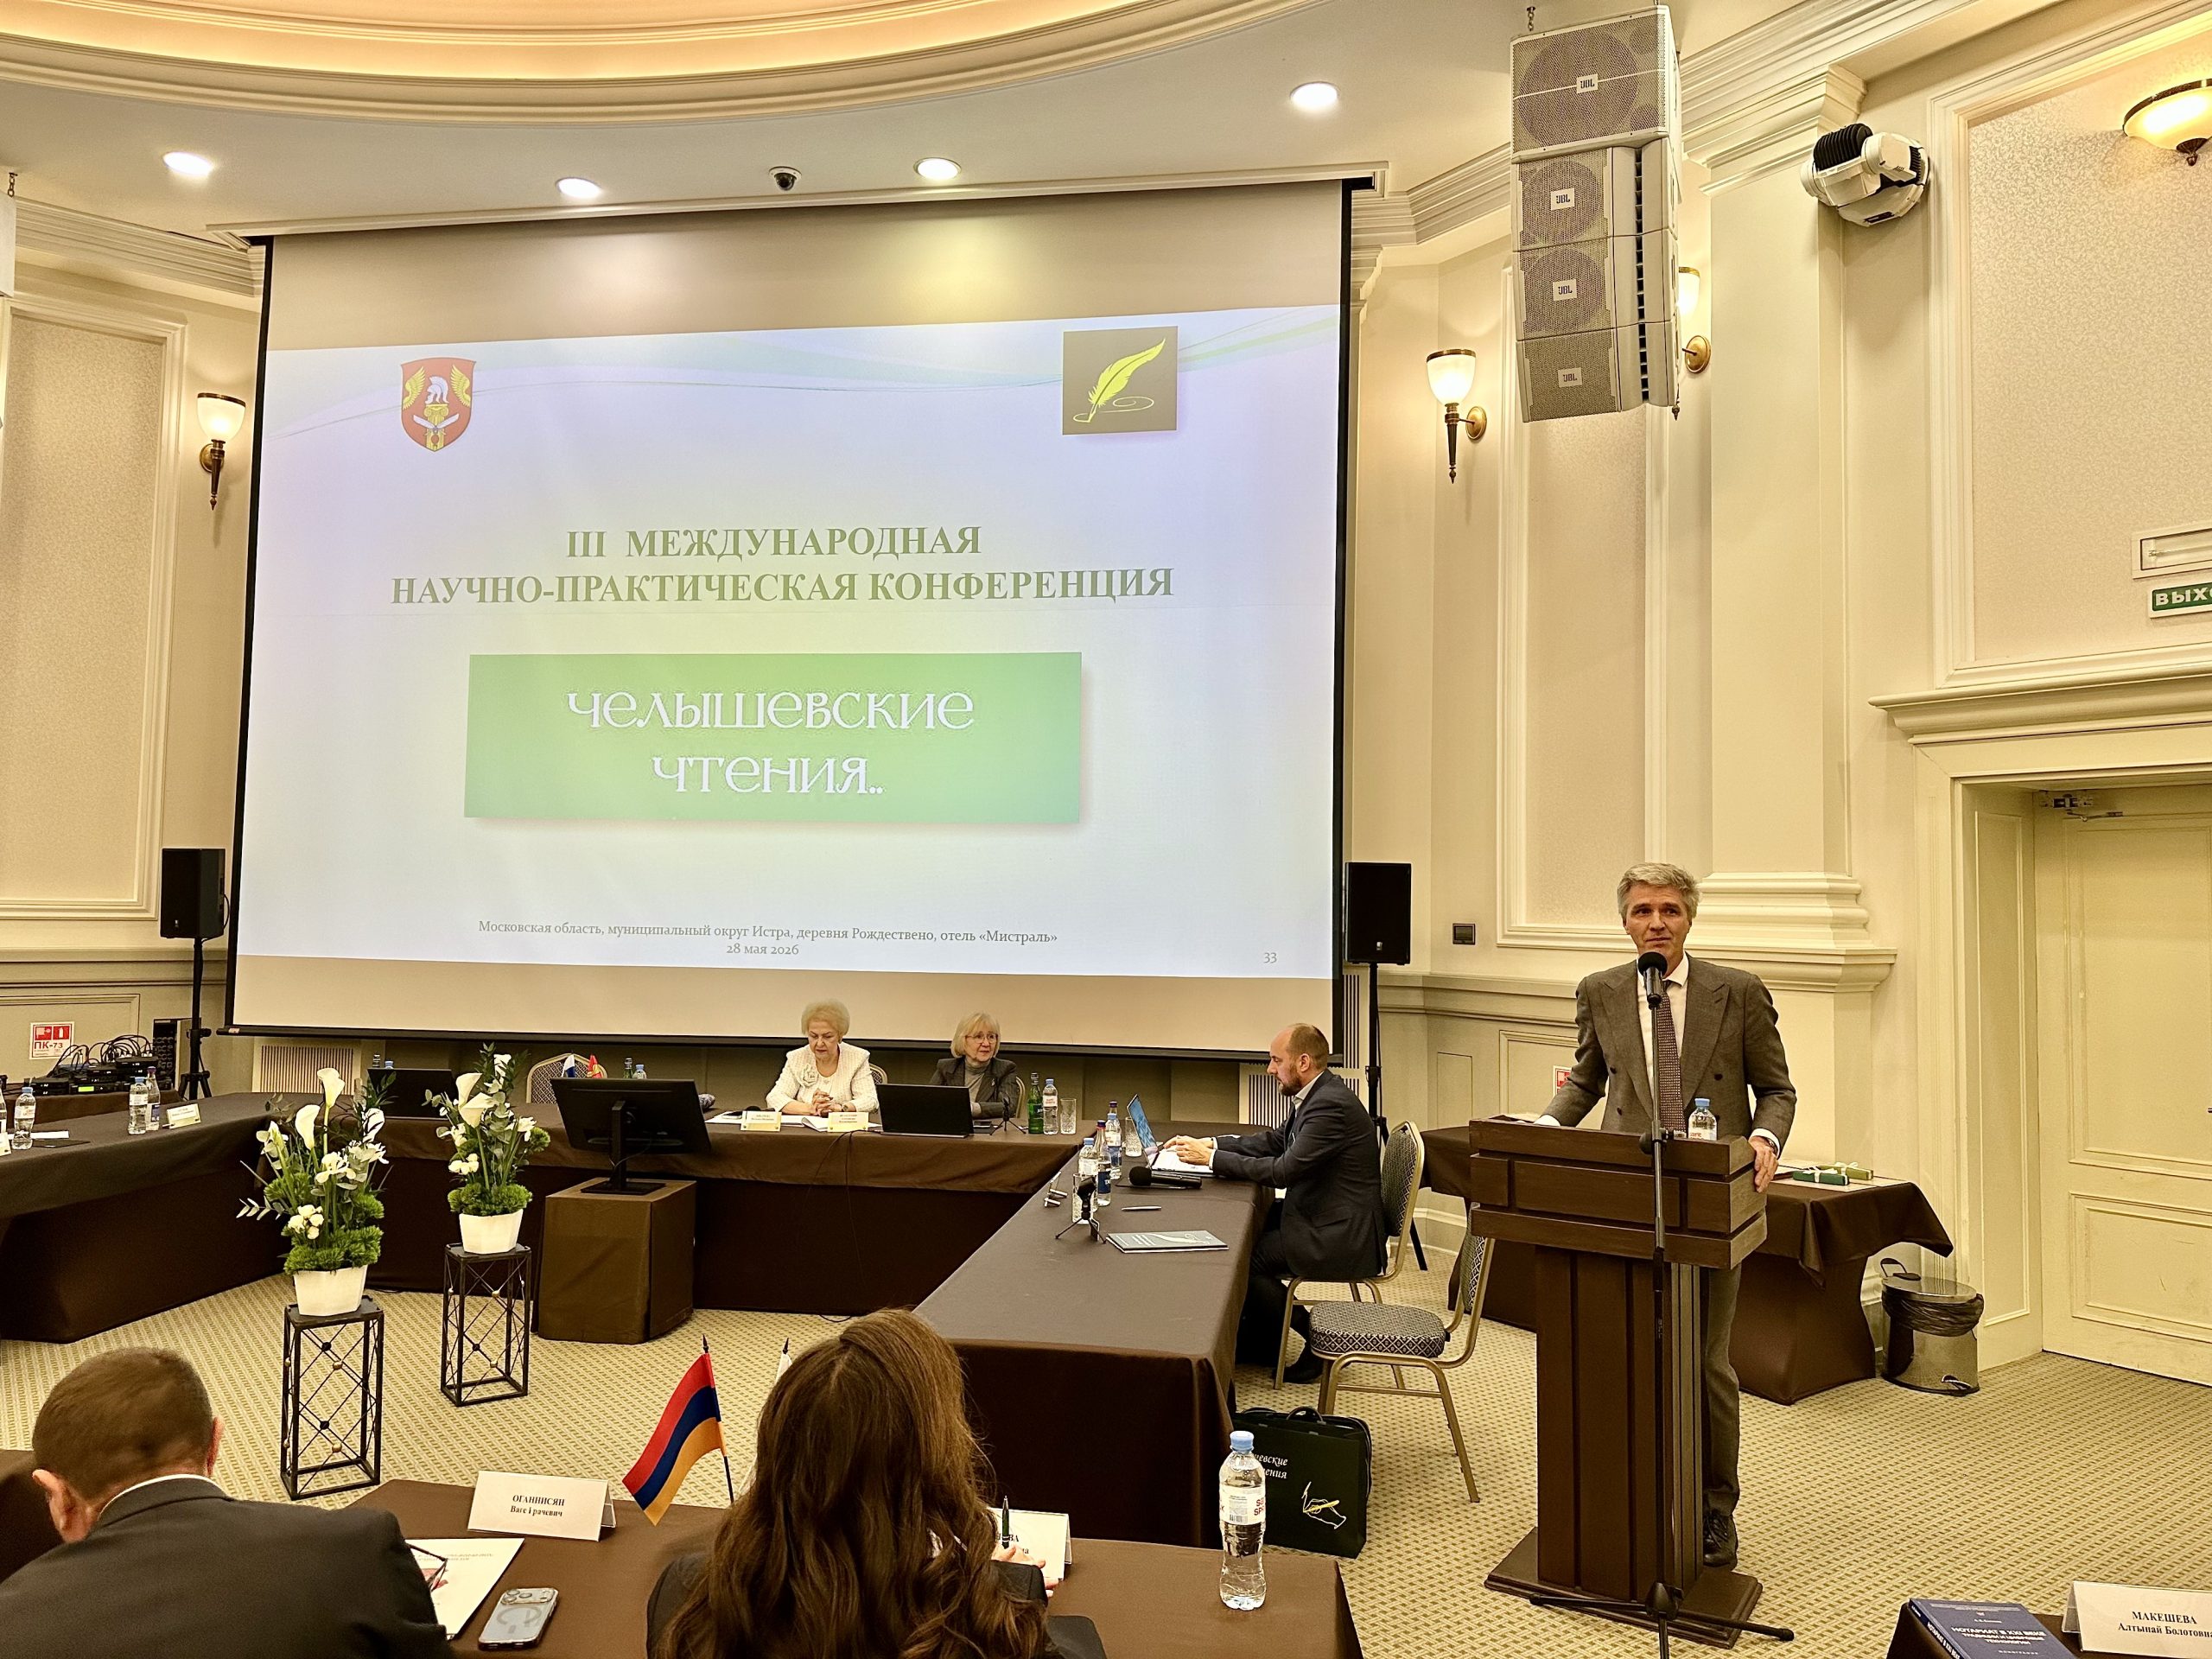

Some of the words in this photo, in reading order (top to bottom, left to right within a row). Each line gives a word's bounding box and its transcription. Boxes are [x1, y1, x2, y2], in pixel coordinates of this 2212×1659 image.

[1556, 194, 1571, 204] JBL
[1558, 285, 1573, 295] JBL
[1563, 373, 1578, 382] JBL
[627, 526, 982, 563] МЕЖДУНАРОДНАЯ
[391, 573, 858, 604] НАУЧНО-ПРАКТИЧЕСКАЯ
[868, 568, 1174, 603] КОНФЕРЕНЦИЯ
[2155, 587, 2212, 606] ВЫХ
[479, 920, 551, 933] Московская
[554, 922, 605, 935] область,
[607, 925, 710, 938] муниципальный
[714, 928, 749, 940] округ
[753, 925, 793, 941] Истра,
[797, 929, 849, 941] деревня
[852, 928, 937, 942] Рождествено,
[940, 932, 976, 941] отель
[979, 931, 1058, 945] «Мистраль»
[726, 943, 741, 954] 28
[744, 945, 767, 955] мая
[771, 944, 799, 956] 2026
[1263, 952, 1277, 964] 33
[34, 1041, 63, 1050] ПК-73
[512, 1495, 565, 1506] ОГАННИСЯН
[2132, 1611, 2197, 1624] МАКЕШЕВА
[2118, 1622, 2163, 1634] Алтынай
